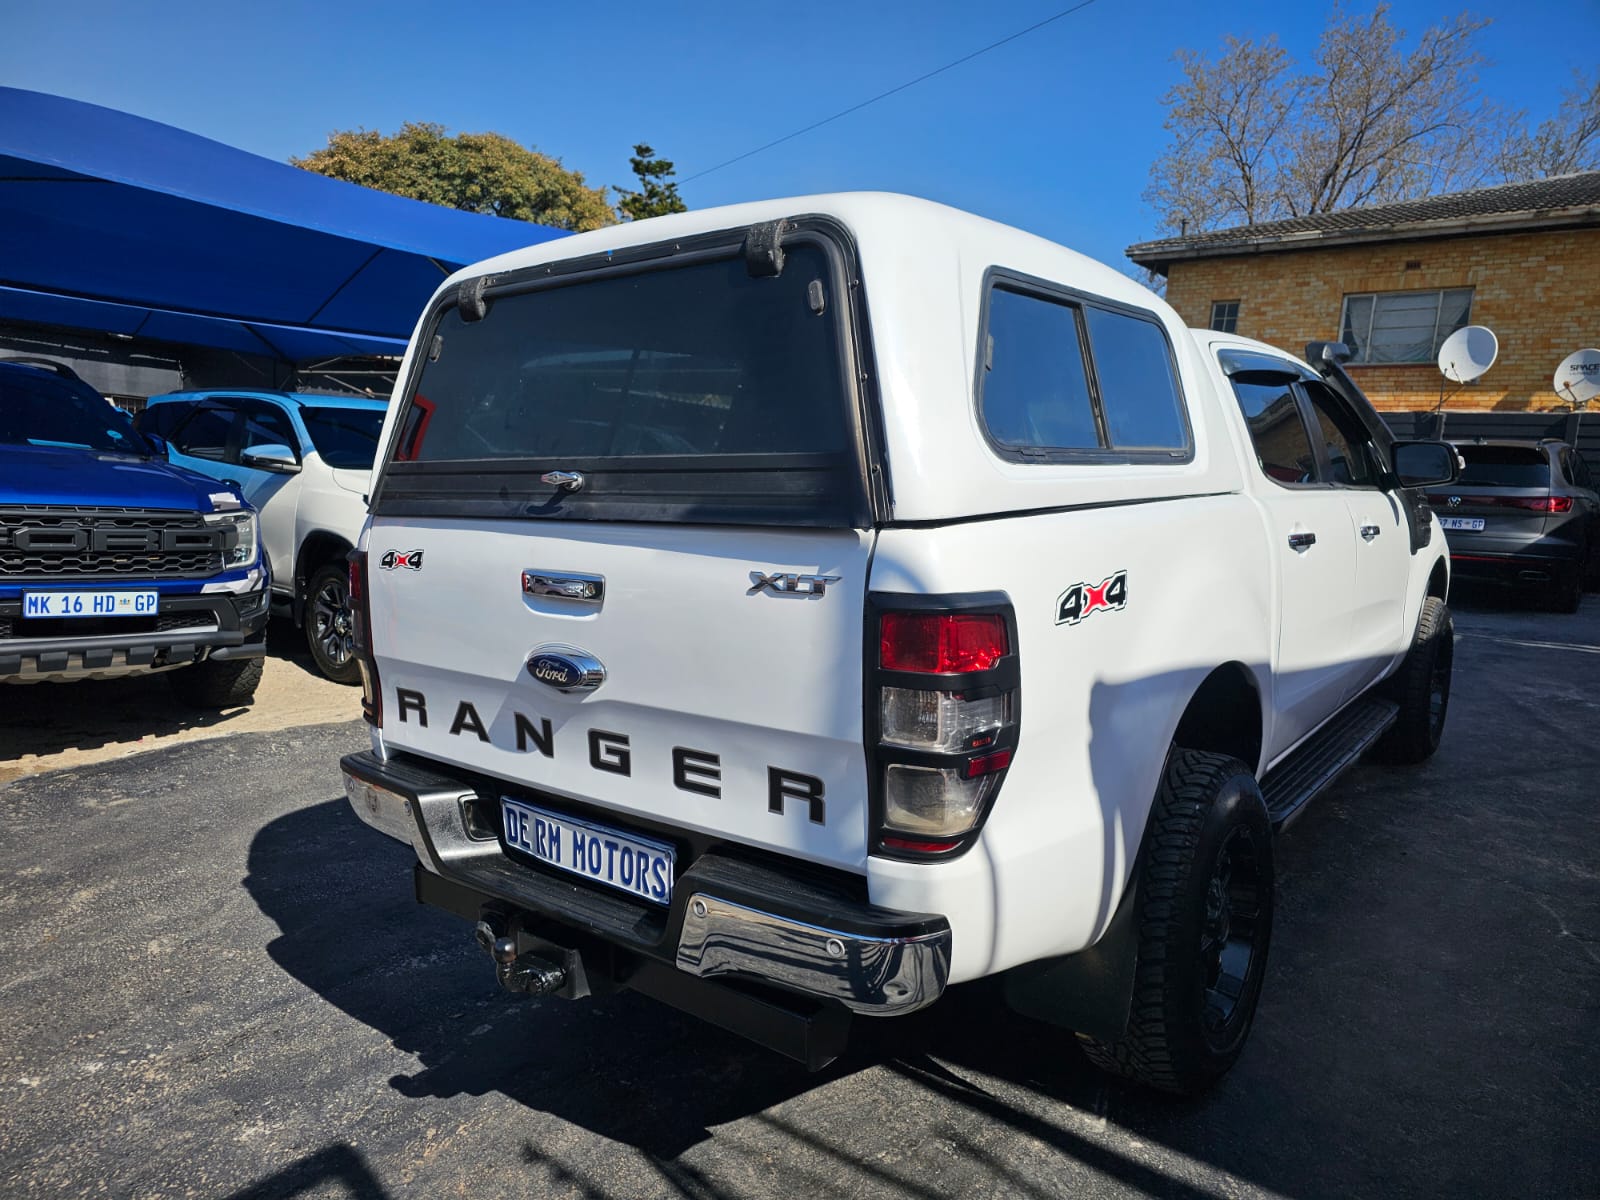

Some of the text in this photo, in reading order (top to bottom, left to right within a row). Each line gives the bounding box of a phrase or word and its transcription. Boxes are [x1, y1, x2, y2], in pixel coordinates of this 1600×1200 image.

[1452, 520, 1463, 528] NS
[1472, 520, 1483, 529] GP
[0, 527, 224, 552] ORD
[746, 571, 843, 597] XLT
[28, 594, 155, 614] MK 16 HD GP
[536, 659, 568, 682] Ford
[396, 687, 826, 827] RANGER
[573, 830, 667, 899] MOTORS
